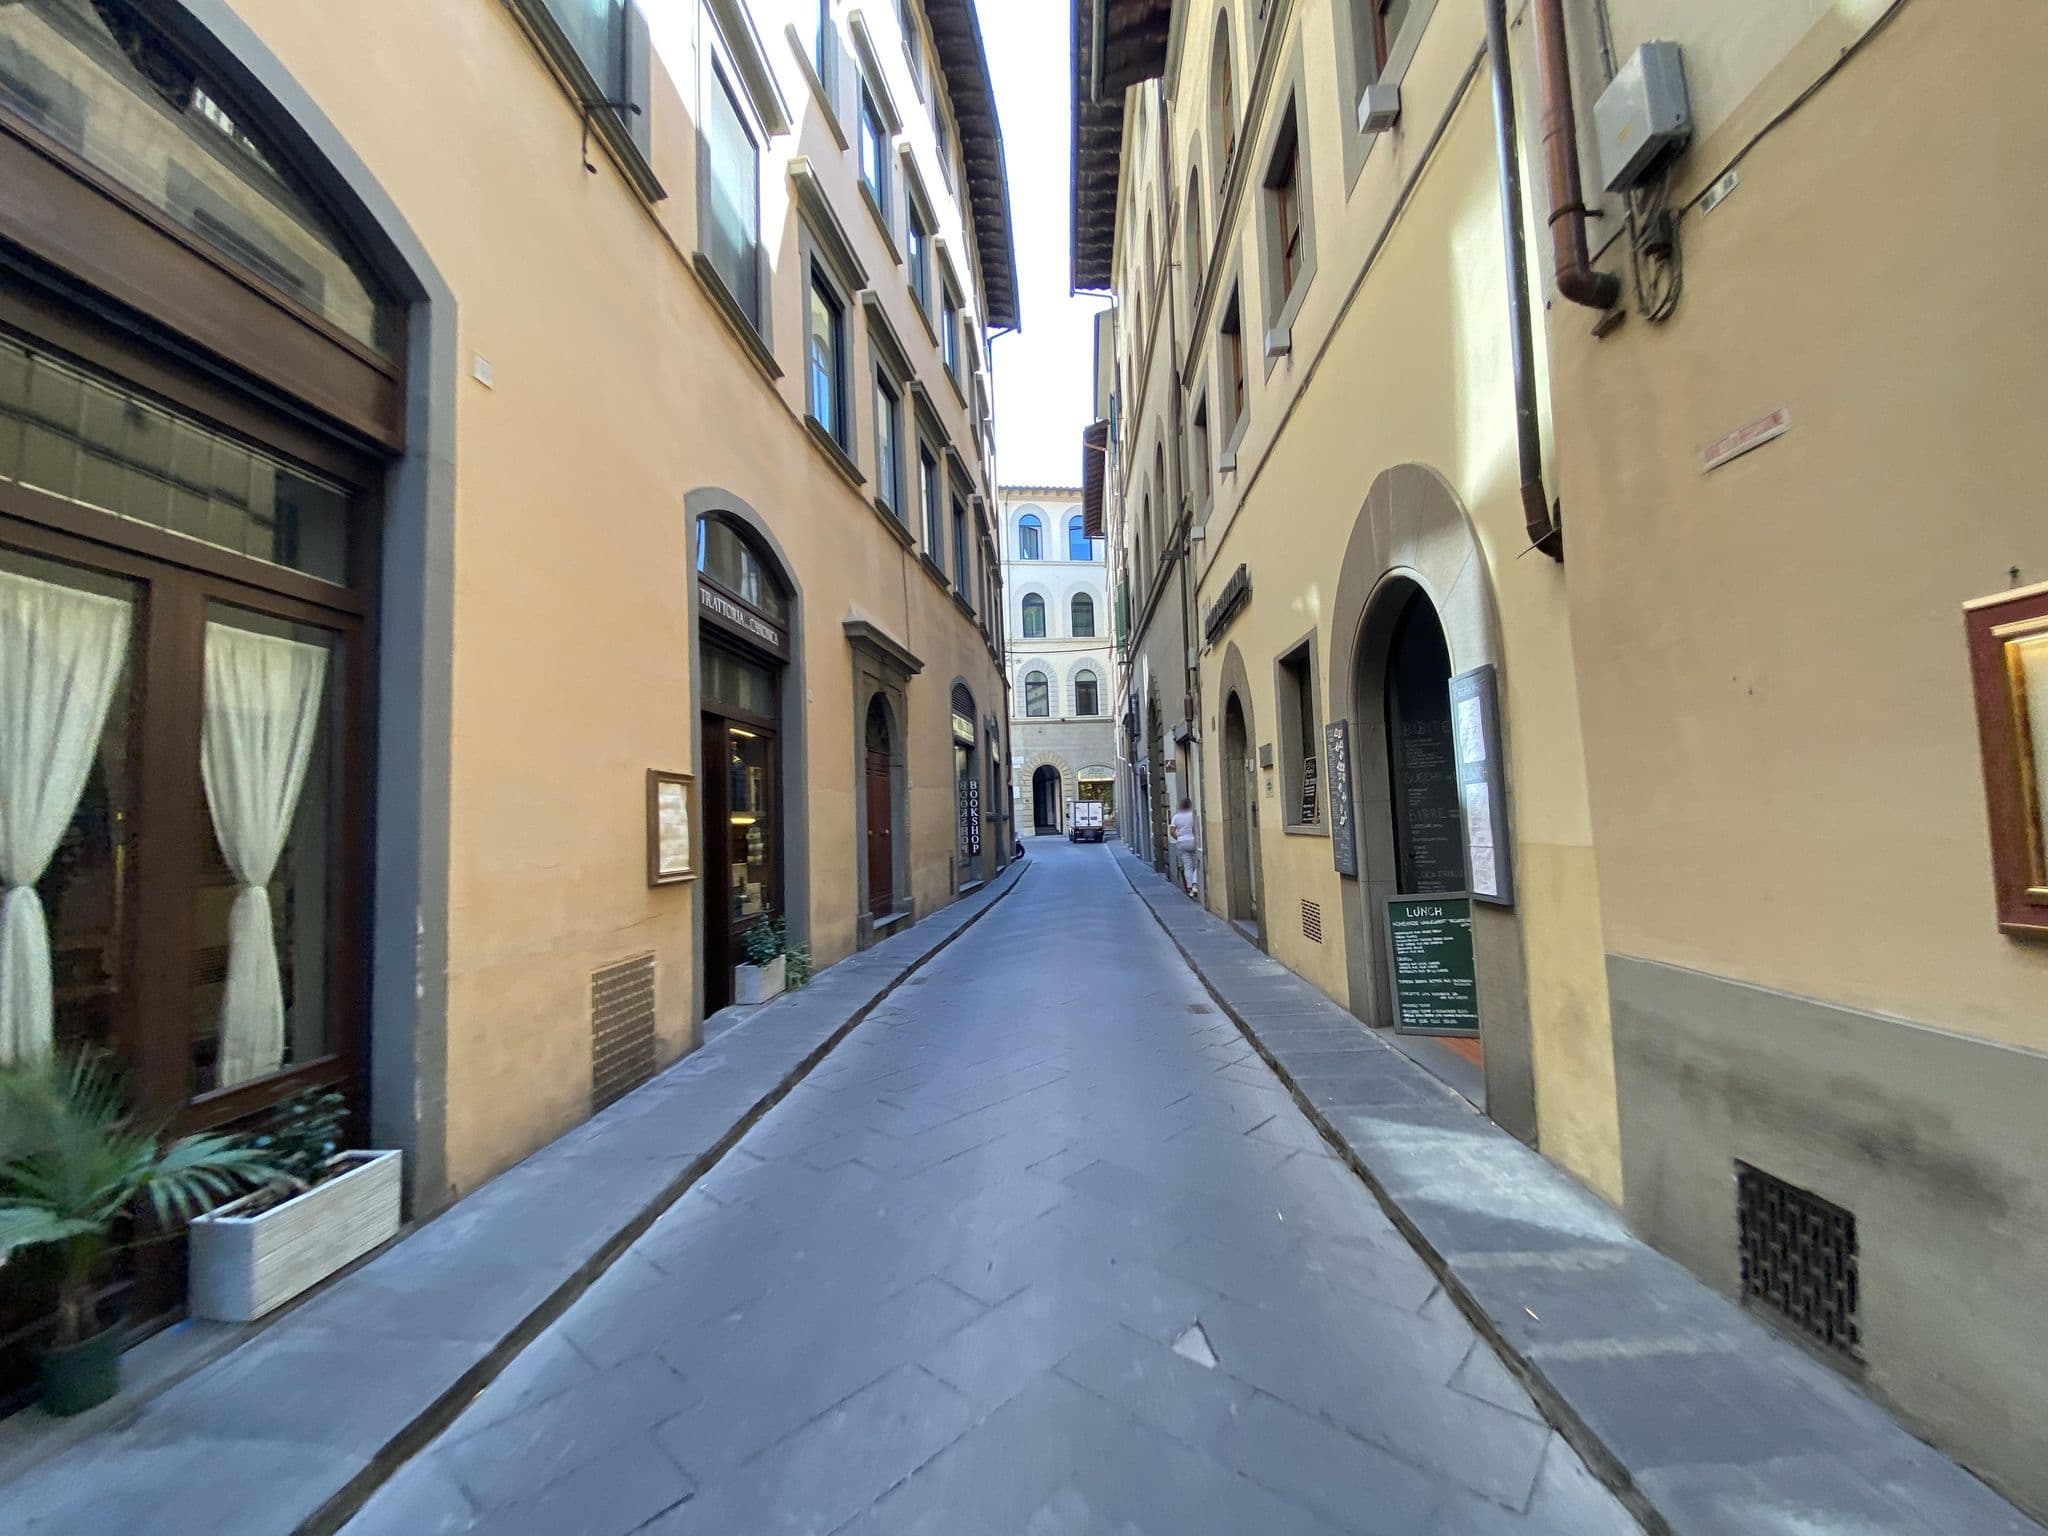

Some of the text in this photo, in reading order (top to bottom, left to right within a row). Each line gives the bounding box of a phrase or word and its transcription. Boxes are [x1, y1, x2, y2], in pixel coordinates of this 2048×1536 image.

[700, 588, 745, 626] TRATTORIA
[969, 781, 980, 854] BOOKSHOP
[1406, 906, 1442, 917] LUNCH
